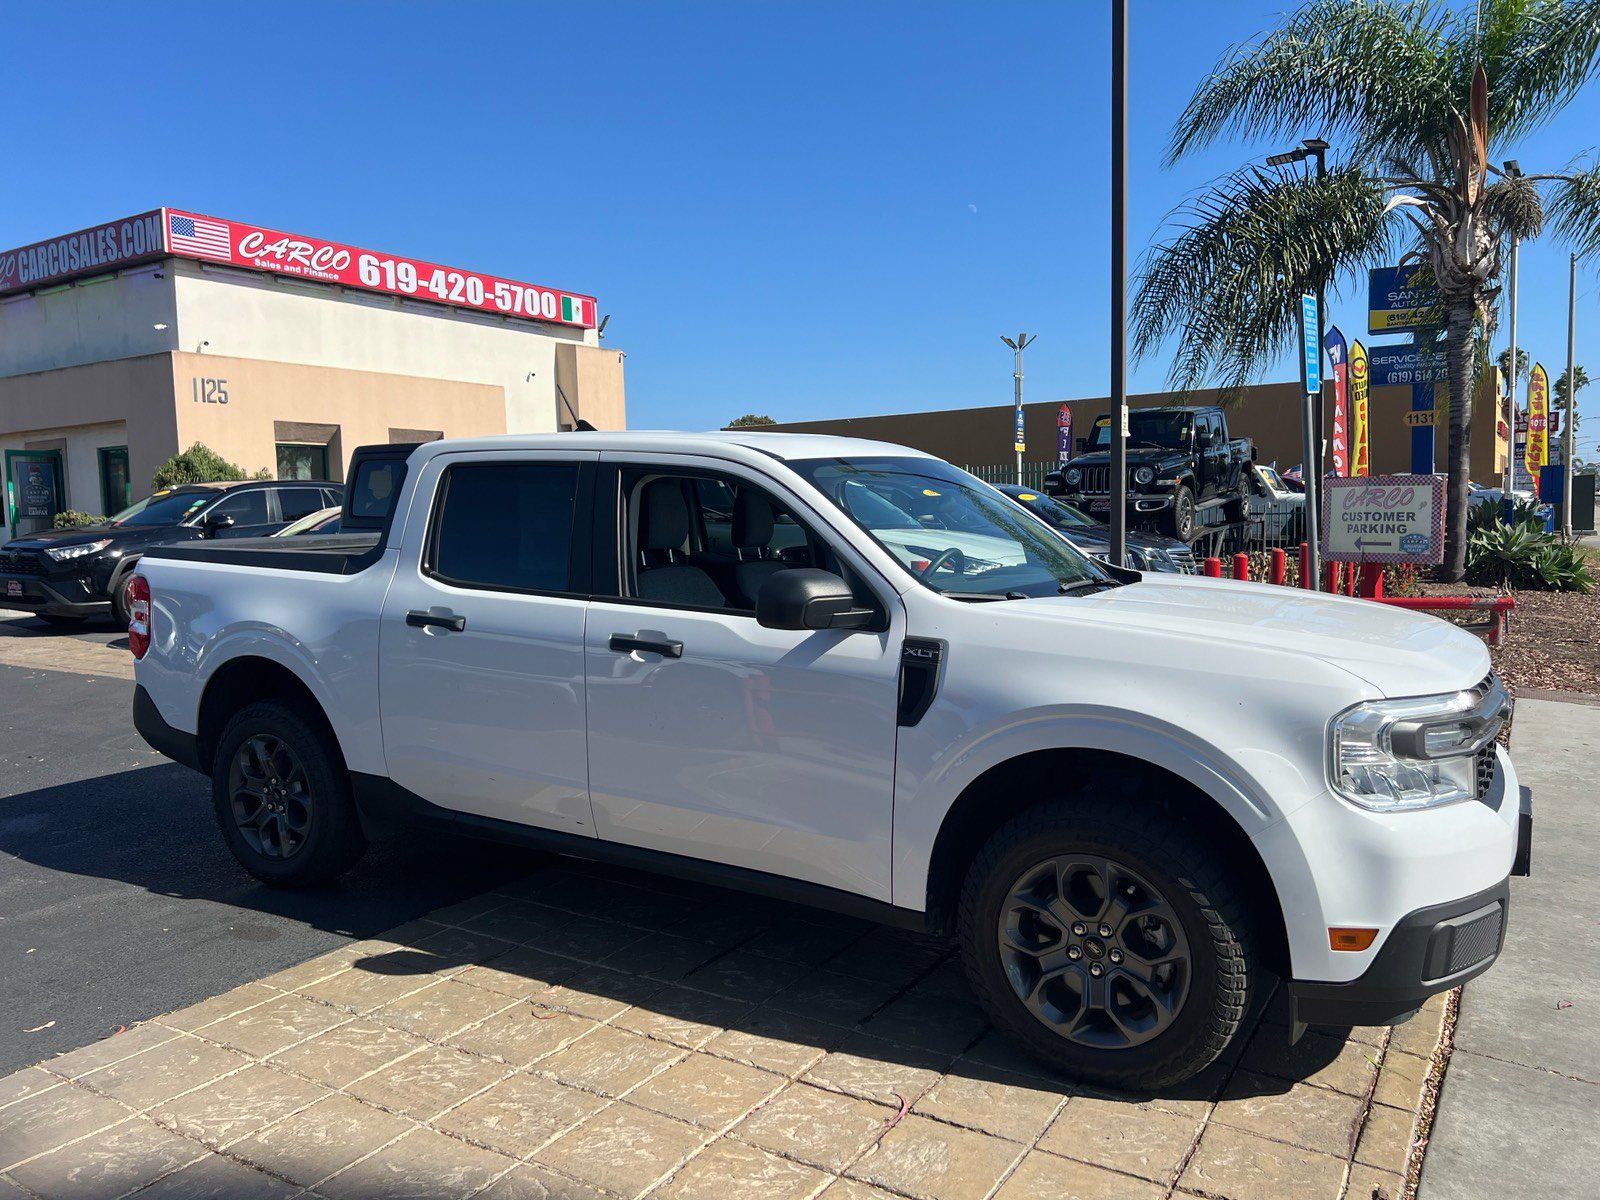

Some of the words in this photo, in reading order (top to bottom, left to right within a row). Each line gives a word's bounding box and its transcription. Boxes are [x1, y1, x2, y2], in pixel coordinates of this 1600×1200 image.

[18, 214, 162, 283] CARCOSALES.COM
[238, 231, 351, 271] CARCO
[254, 258, 281, 270] Sales
[284, 264, 301, 274] and
[304, 267, 340, 280] Finance
[358, 254, 557, 319] 619-420-5700
[1372, 353, 1423, 365] SERVICE
[1387, 370, 1412, 383] (619)
[193, 377, 229, 404] 1125
[1406, 412, 1434, 424] 1131
[1342, 486, 1415, 510] CARCO
[1341, 511, 1416, 522] CUSTOMER
[1347, 524, 1408, 534] PARKING
[904, 647, 939, 658] XLT
